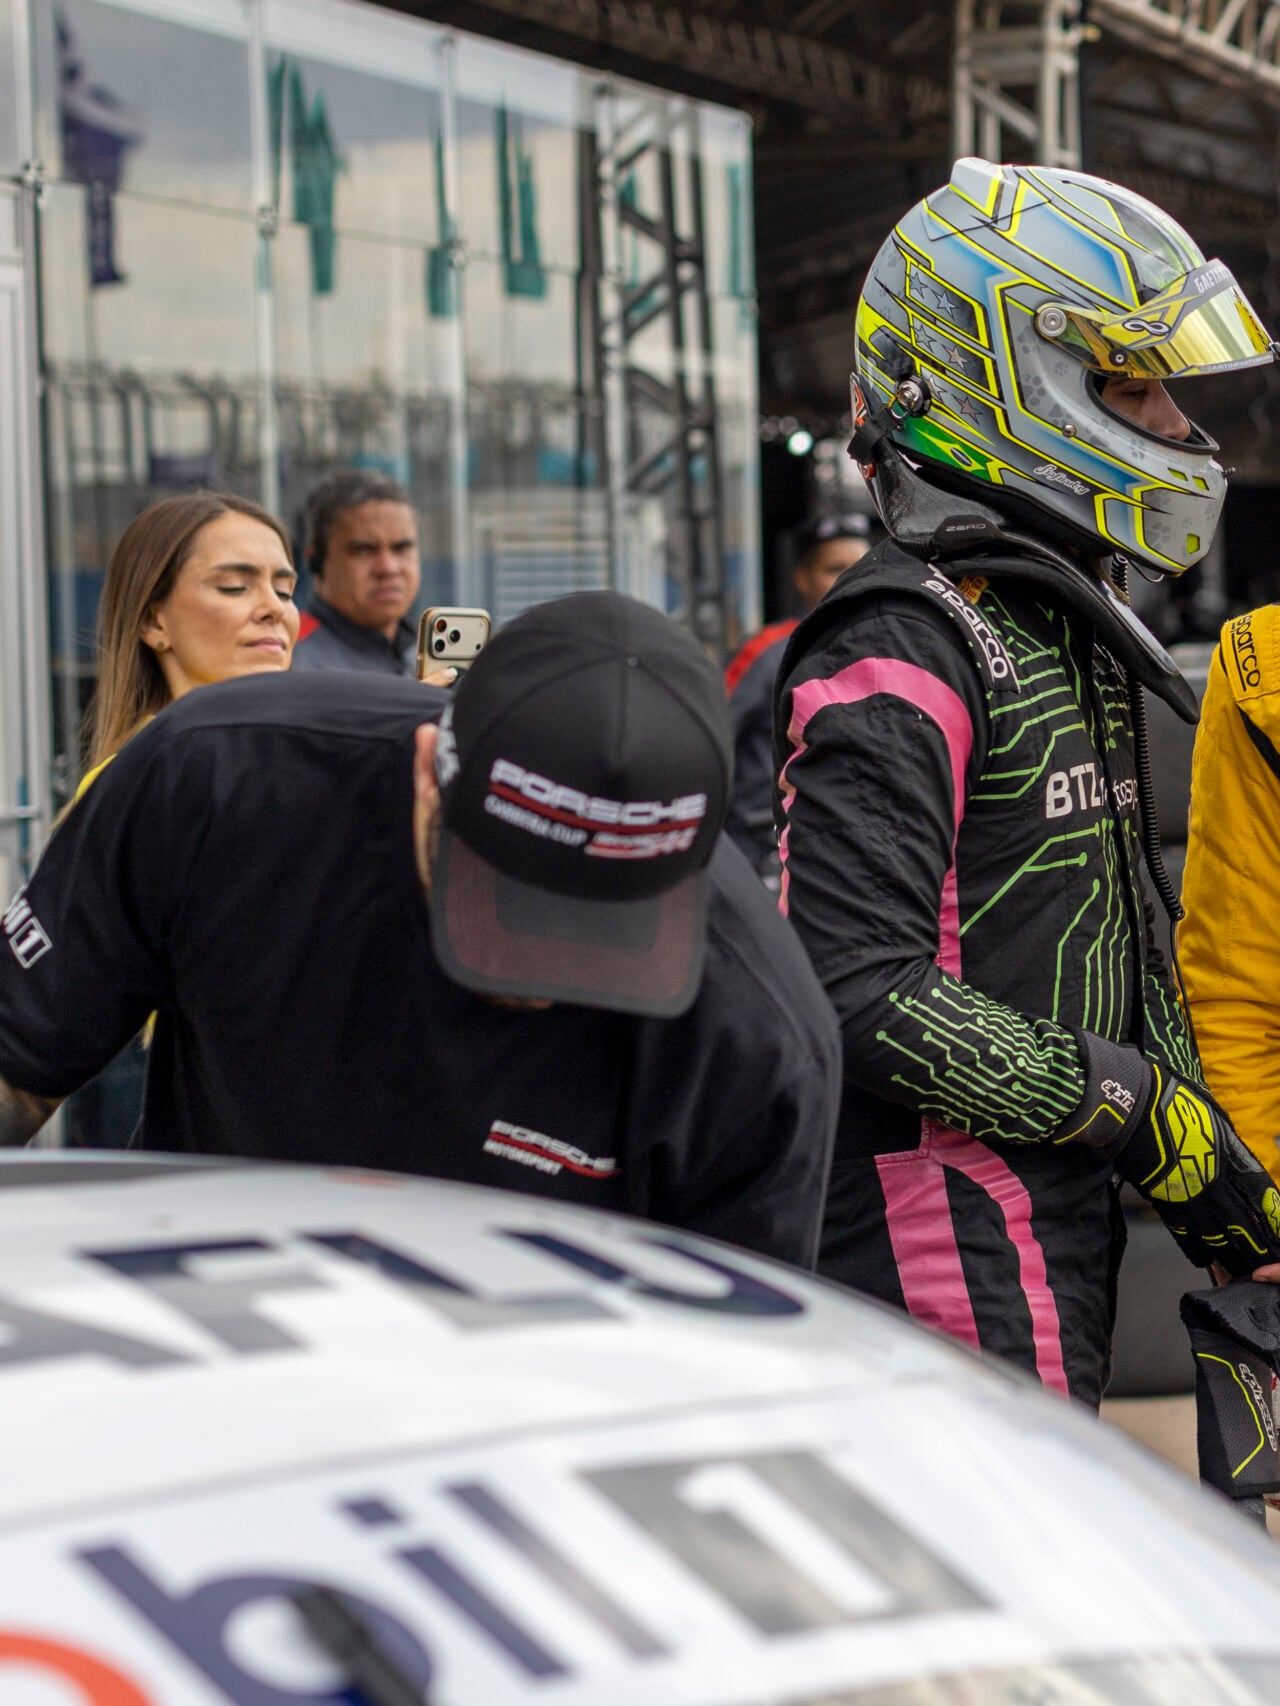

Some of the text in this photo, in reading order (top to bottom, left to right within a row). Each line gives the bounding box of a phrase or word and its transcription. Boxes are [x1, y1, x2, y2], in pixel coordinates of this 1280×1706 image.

[1033, 464, 1090, 495] Infinity
[945, 522, 986, 532] ZERO
[1231, 614, 1261, 690] sparco
[490, 757, 707, 824] PORSCHE
[490, 1119, 616, 1171] PORSCHE
